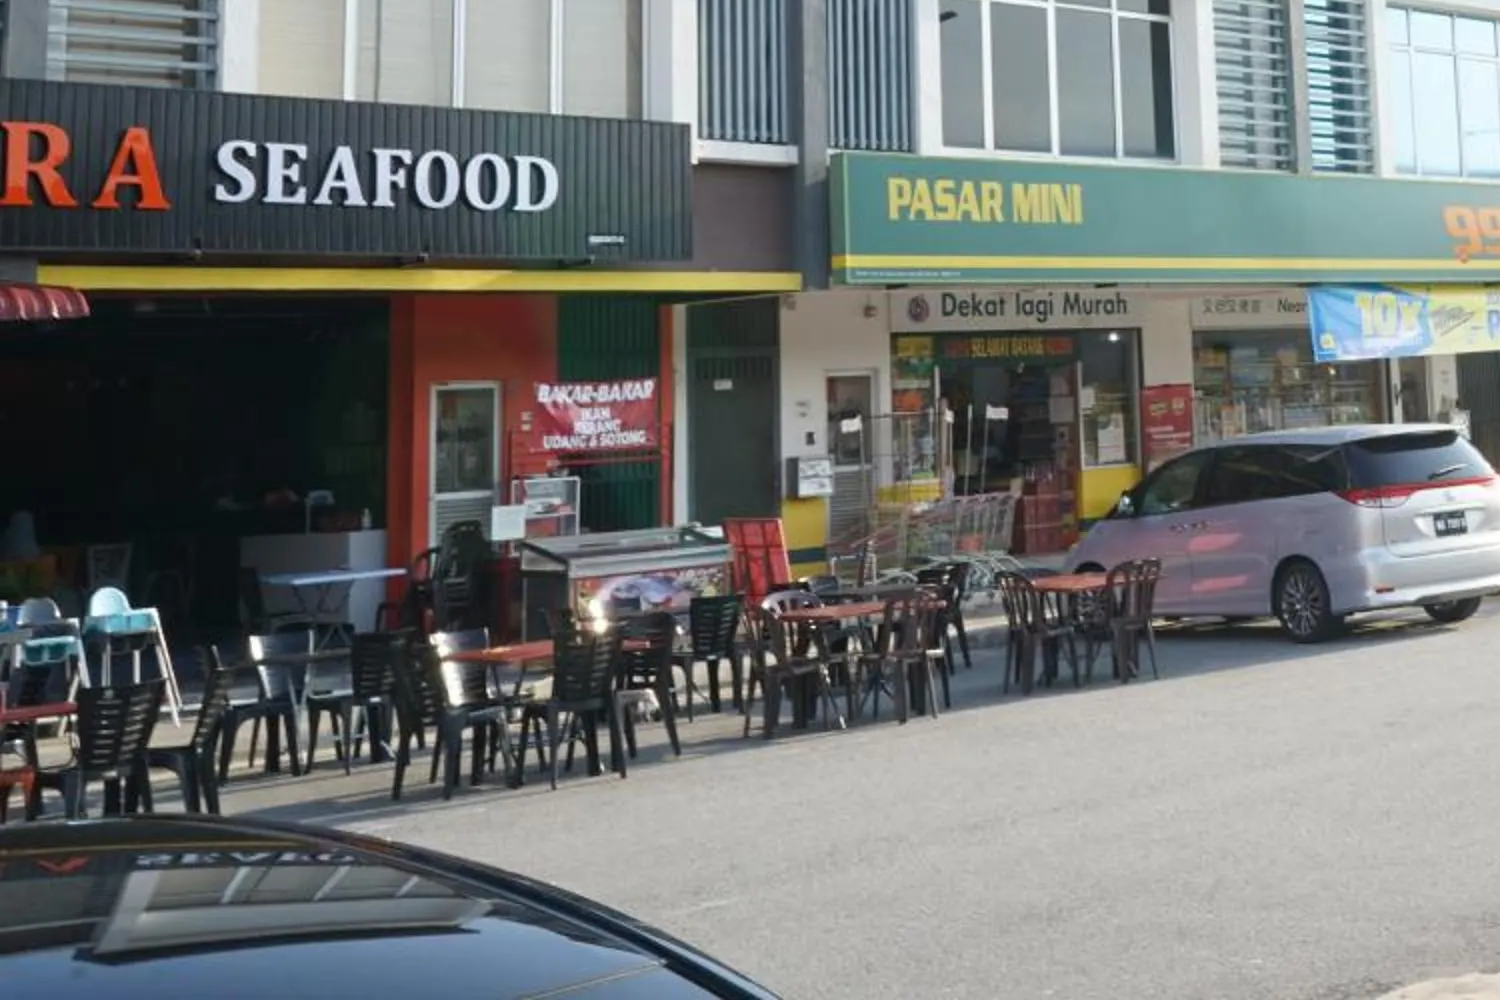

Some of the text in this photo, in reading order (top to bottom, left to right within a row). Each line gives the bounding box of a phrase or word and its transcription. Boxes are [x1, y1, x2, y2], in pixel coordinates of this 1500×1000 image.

[215, 140, 559, 212] SEAFOOD
[888, 177, 1083, 224] PASAR MINI
[941, 292, 1127, 322] Dekat lagi Murah
